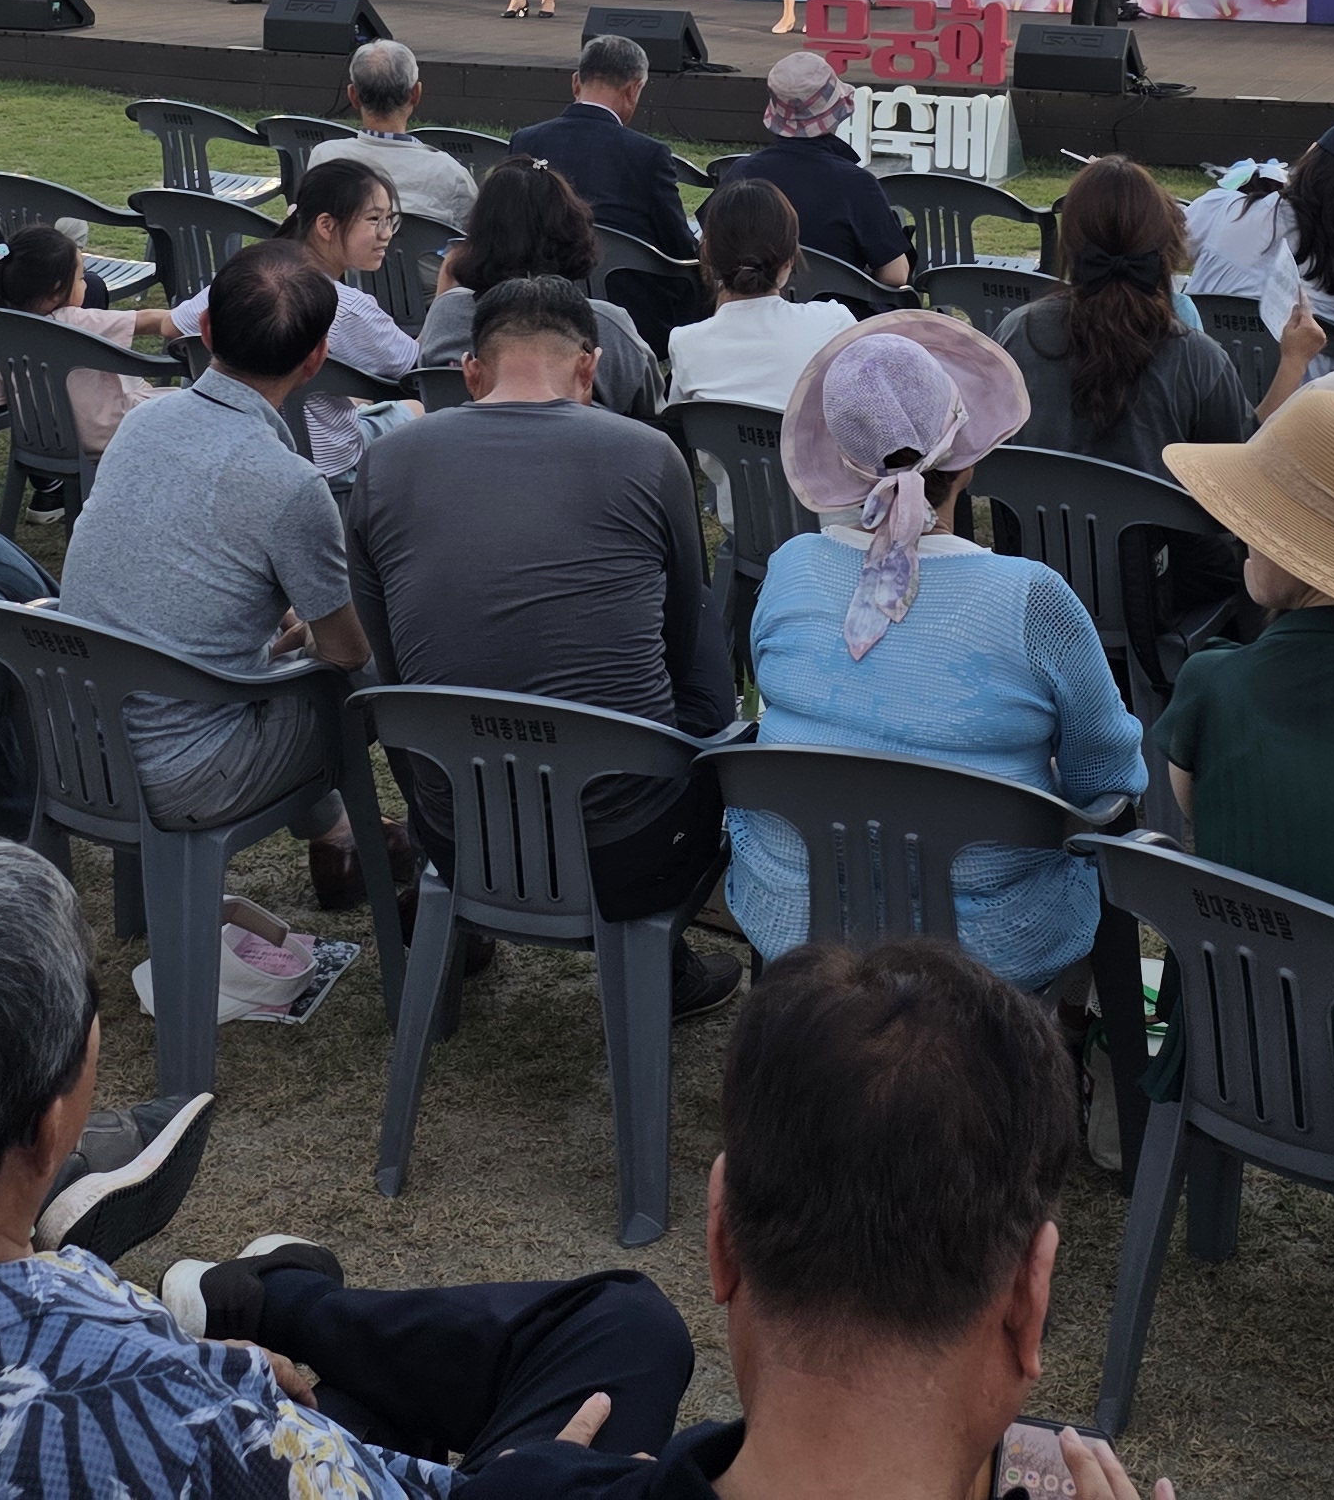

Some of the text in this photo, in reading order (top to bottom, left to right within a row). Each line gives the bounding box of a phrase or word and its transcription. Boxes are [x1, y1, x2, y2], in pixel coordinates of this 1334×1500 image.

[738, 424, 780, 448] 현대종합
[470, 713, 557, 744] 현대종합렌탈
[1191, 888, 1295, 942] 현대종합렌탈
